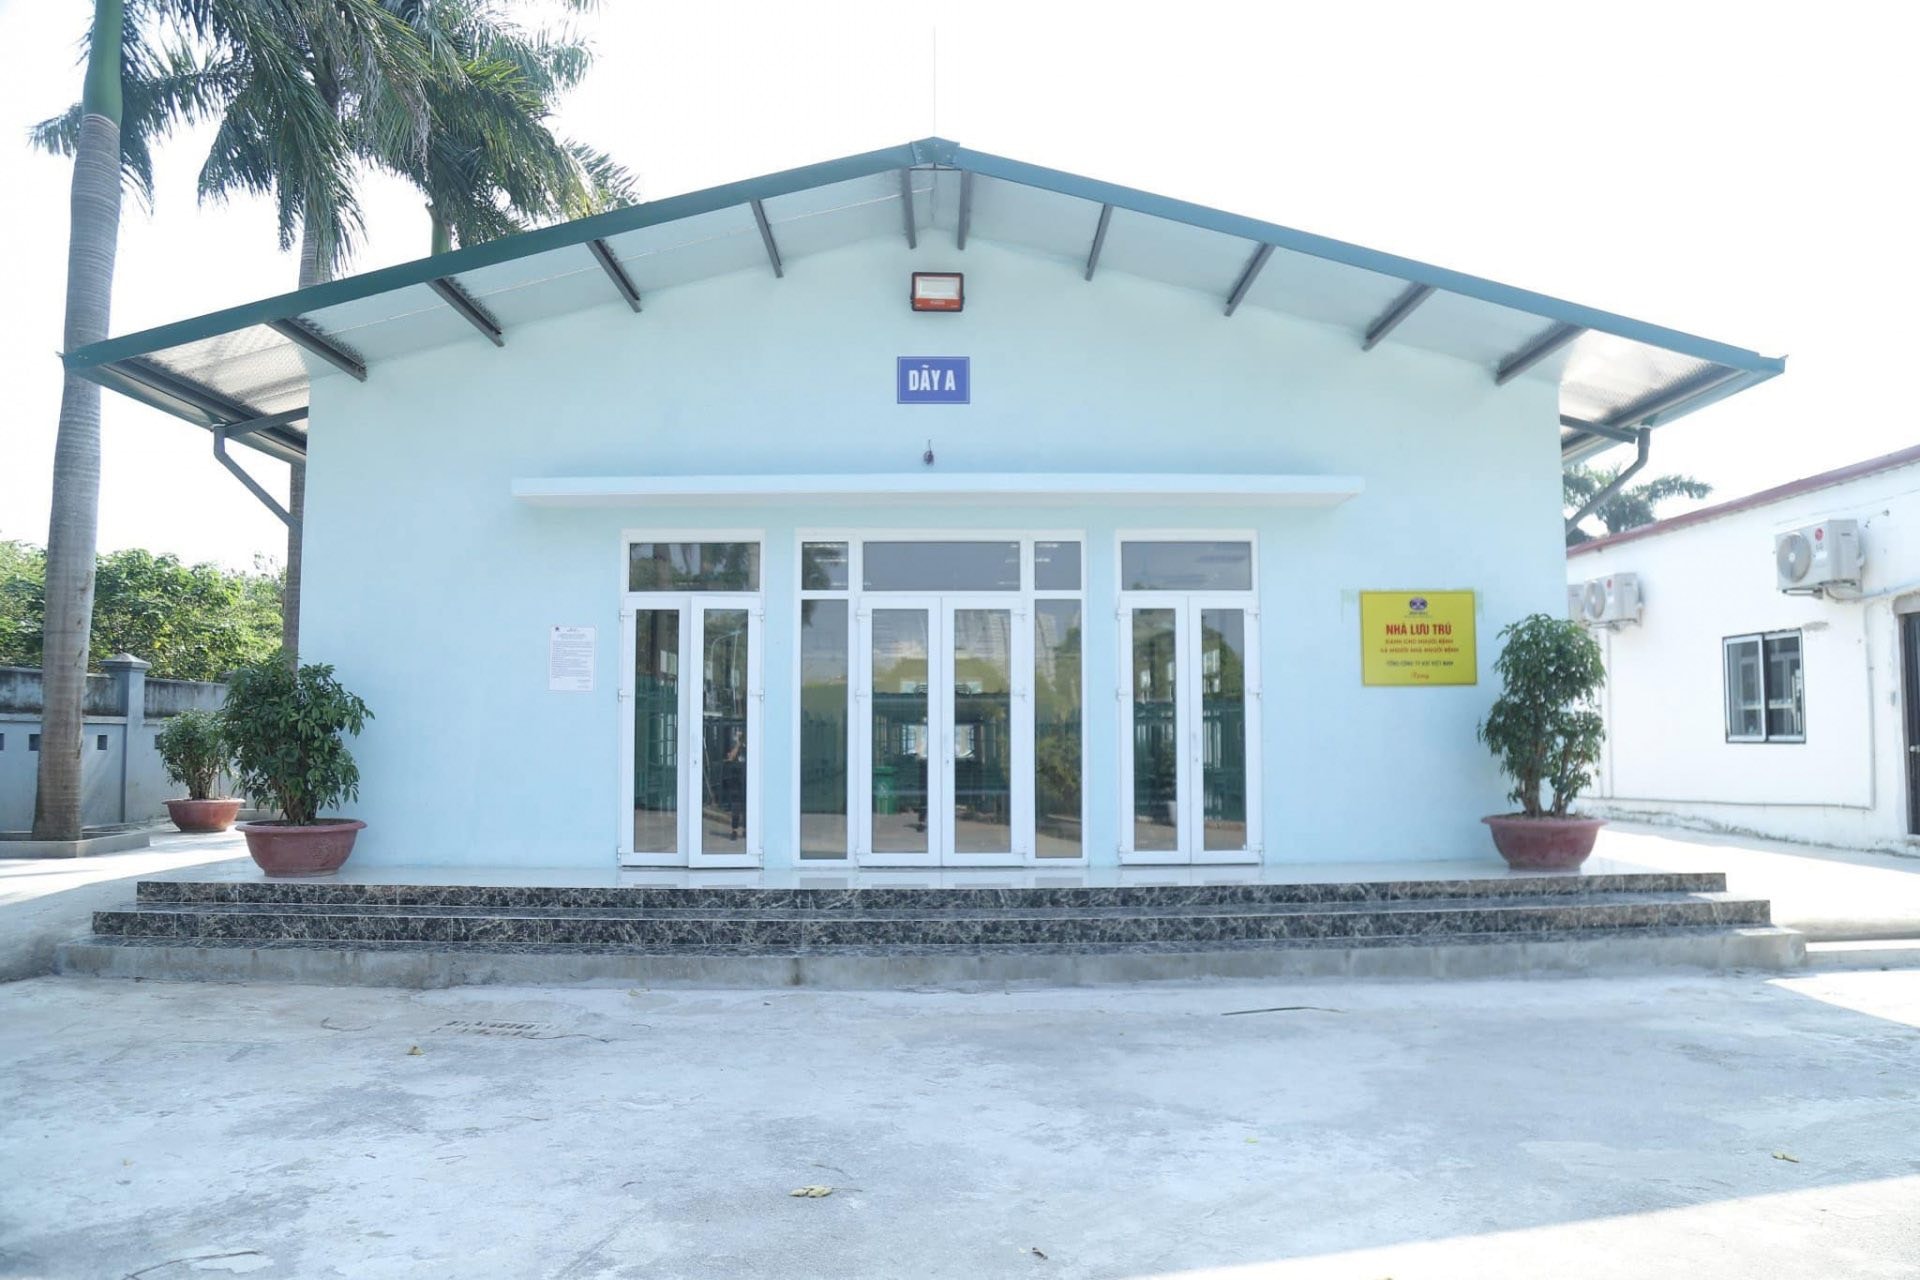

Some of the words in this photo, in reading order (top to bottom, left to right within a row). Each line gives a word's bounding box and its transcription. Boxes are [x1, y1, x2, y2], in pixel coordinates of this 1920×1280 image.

[908, 364, 941, 391] DÃY
[944, 369, 957, 391] A
[1385, 622, 1407, 635] NHÀ
[1410, 623, 1430, 635] LƯU
[1433, 622, 1452, 635] TRÚ
